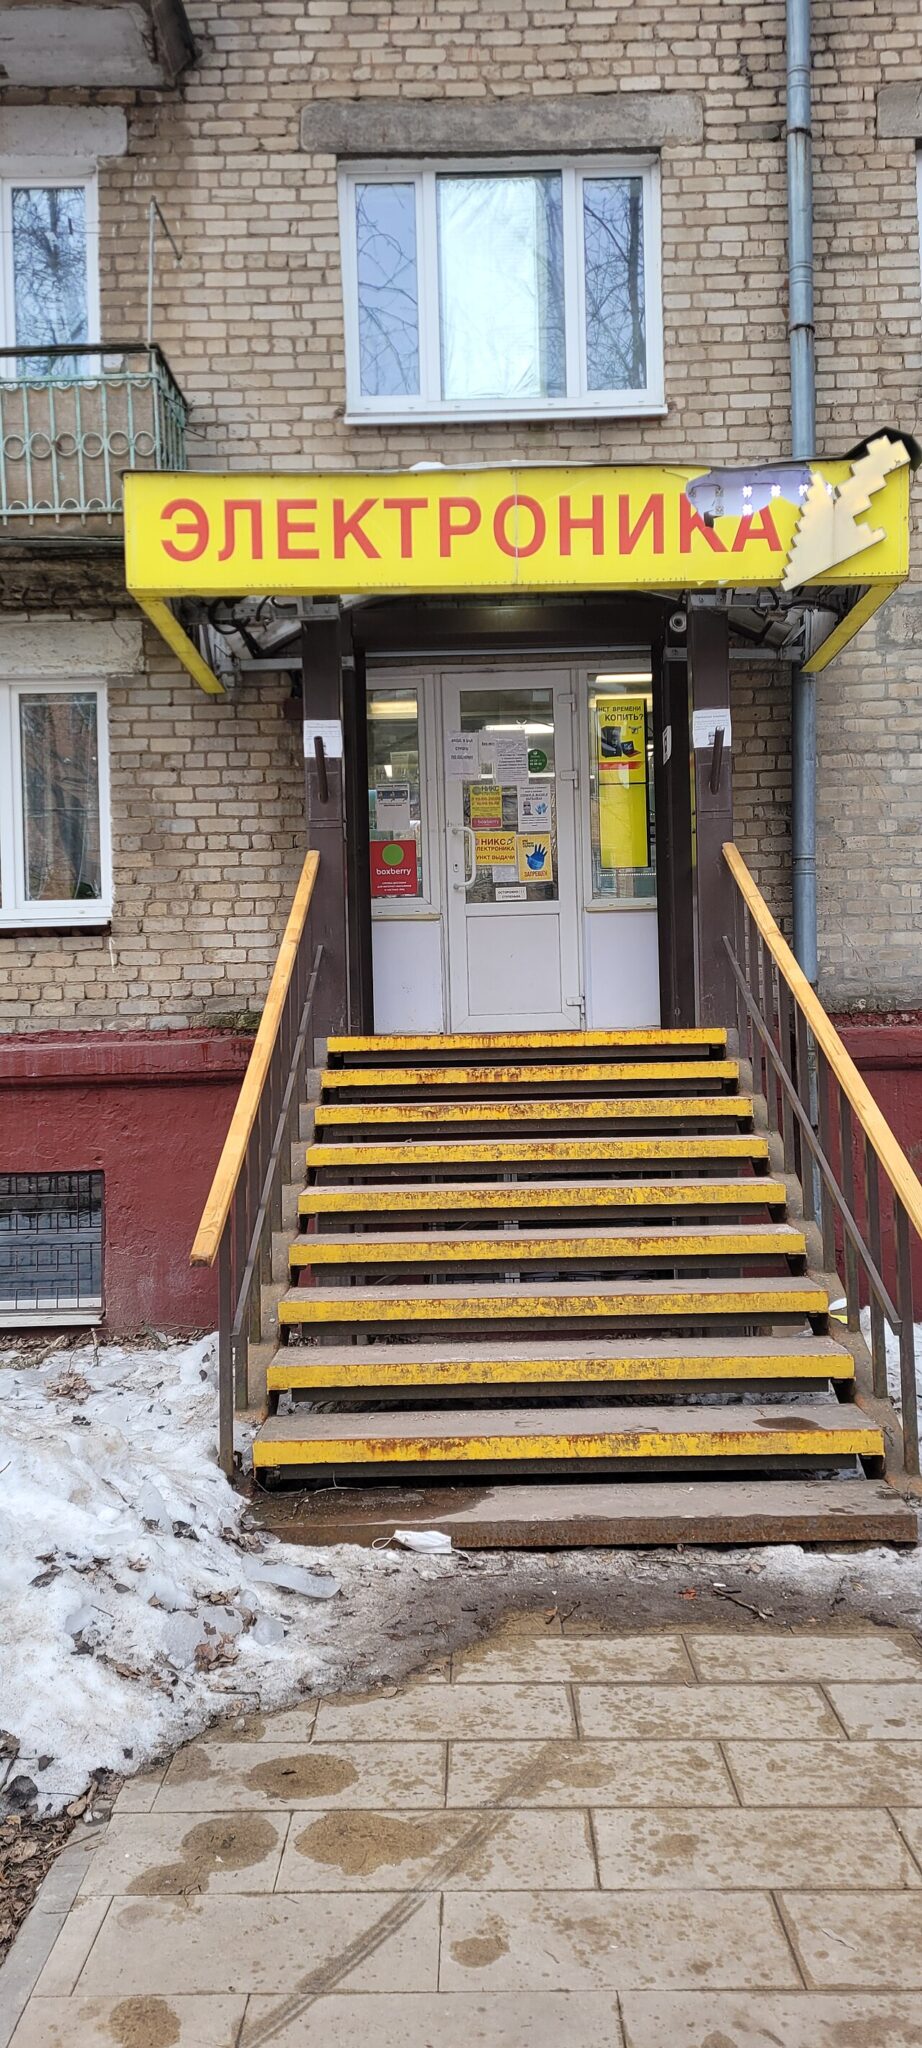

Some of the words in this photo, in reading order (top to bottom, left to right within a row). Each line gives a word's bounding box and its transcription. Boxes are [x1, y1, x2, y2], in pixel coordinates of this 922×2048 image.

[160, 493, 783, 562] ЭЛЕКТРОНИКА
[604, 713, 644, 721] КОПИТЬ?
[481, 838, 506, 846] НИКС
[376, 867, 411, 876] boxberry
